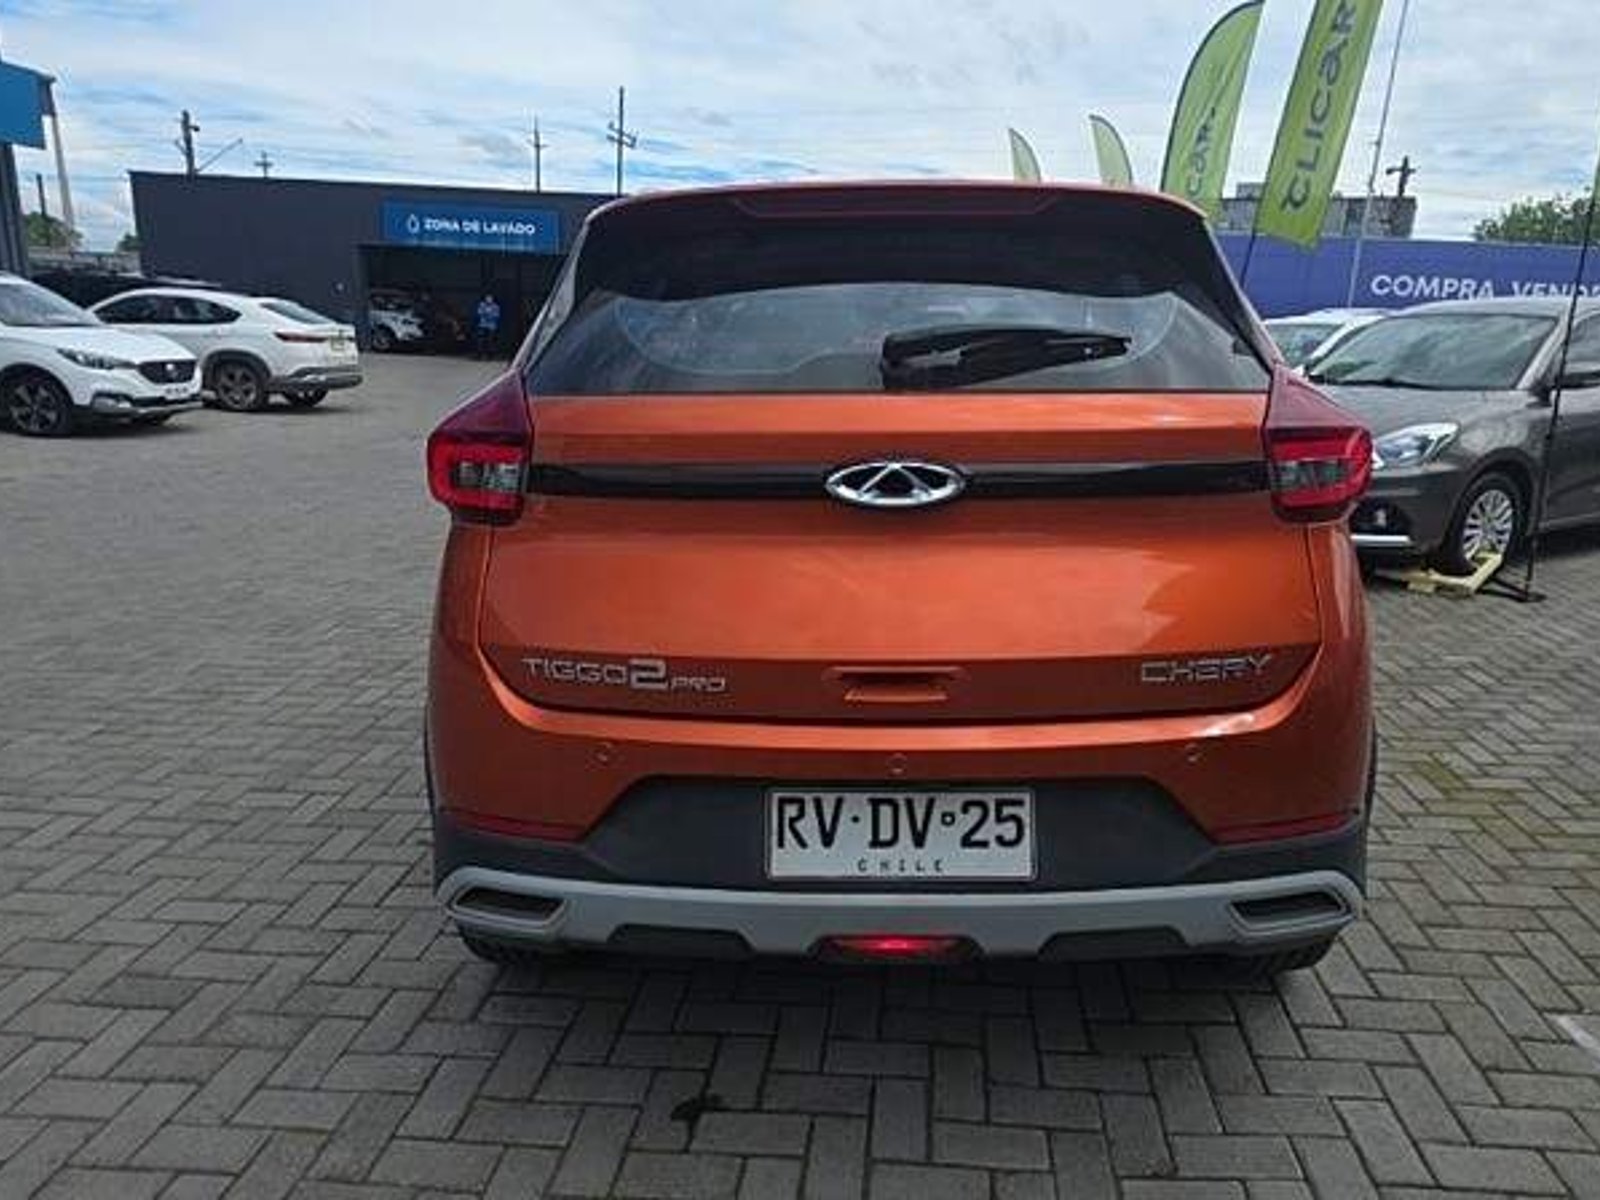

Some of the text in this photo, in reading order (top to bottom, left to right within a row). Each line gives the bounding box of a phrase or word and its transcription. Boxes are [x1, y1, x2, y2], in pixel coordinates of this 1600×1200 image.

[423, 218, 535, 236] ZONA DE LAVADO
[1371, 275, 1494, 300] COMPRA
[521, 658, 627, 684] TIGGO
[1141, 654, 1272, 681] CHERY
[857, 859, 945, 873] CHILE
